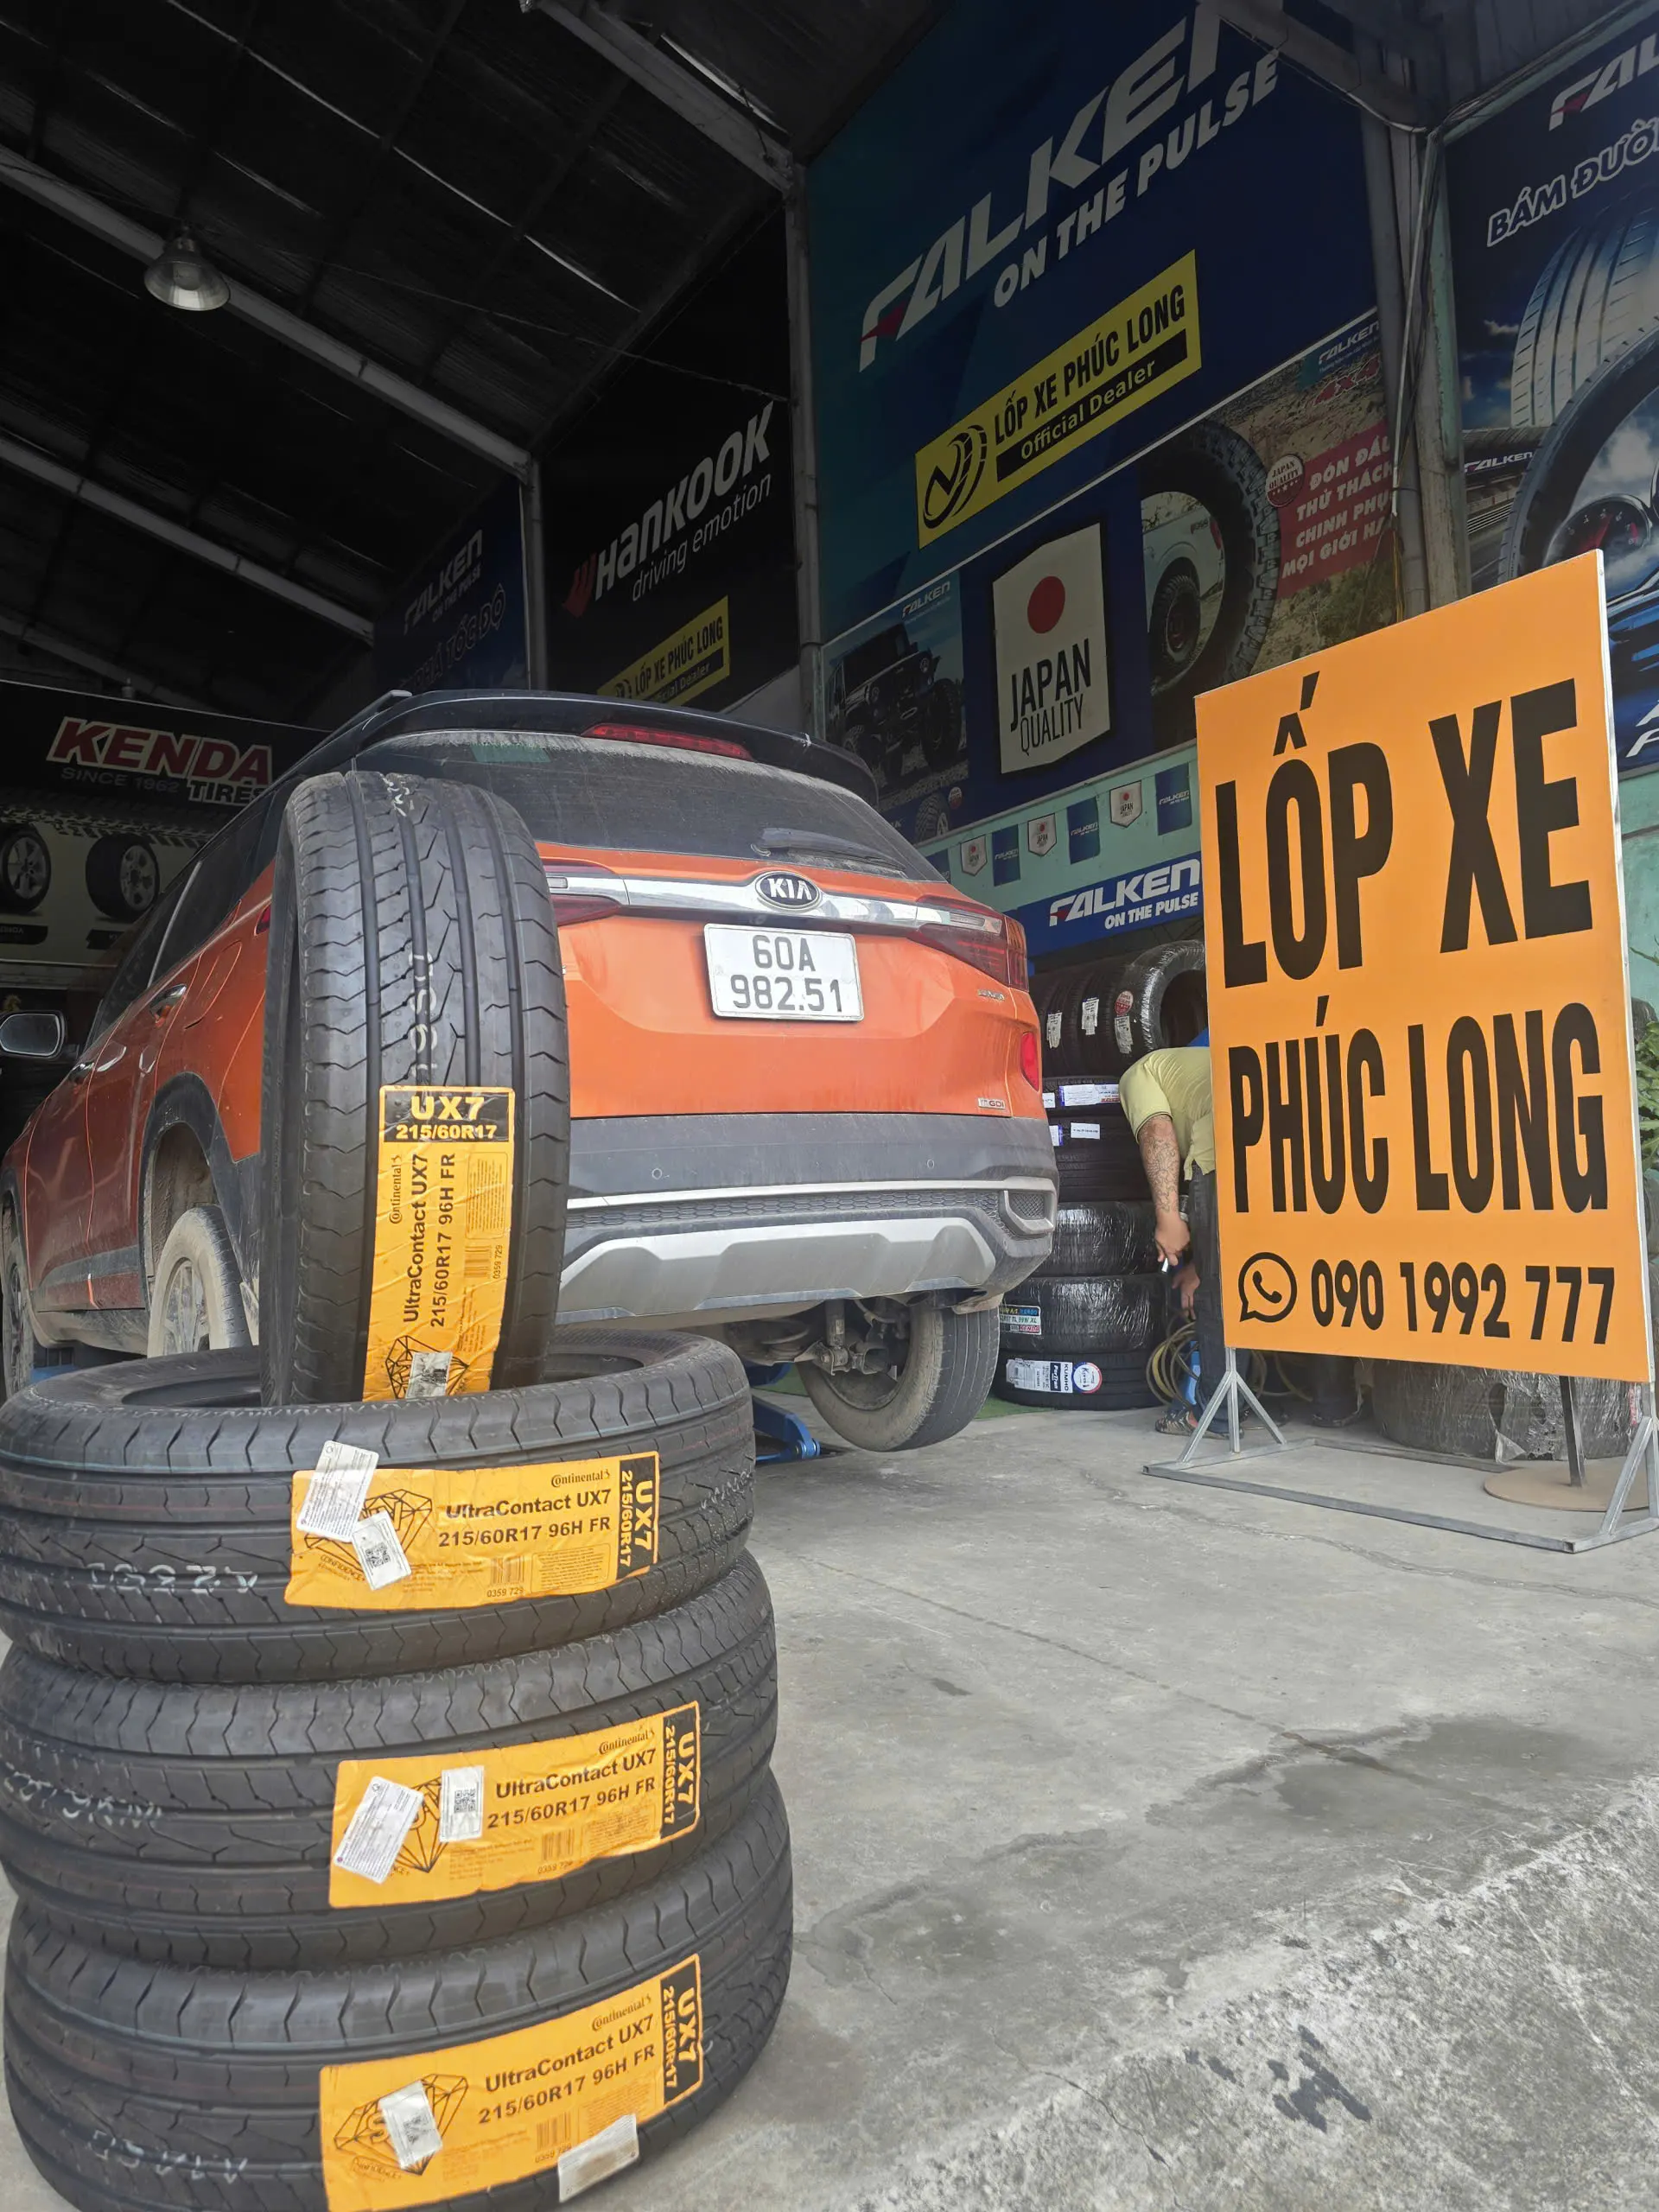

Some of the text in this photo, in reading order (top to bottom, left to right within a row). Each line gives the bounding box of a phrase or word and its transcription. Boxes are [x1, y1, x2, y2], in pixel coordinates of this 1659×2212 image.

[993, 48, 1280, 308] ON THE PULSE
[1487, 117, 1659, 247] BÁM ĐƯỜ
[993, 283, 1185, 446] LỐP XE PHÚC LONG
[1020, 358, 1156, 461] Official Dealer
[1269, 467, 1300, 489] QUALITY
[1272, 460, 1296, 478] JAPAN
[1310, 456, 1350, 491] ĐÓN
[1464, 451, 1533, 473] FALKEN
[632, 474, 771, 601] driving emotion
[1282, 550, 1314, 578] MỌI
[1320, 530, 1358, 560] GIỚI
[1296, 510, 1347, 548] CHINH
[404, 529, 483, 636] FALKEN
[634, 616, 723, 696] LỐP XE PHÚC LONG
[680, 662, 710, 690] Dealer
[1010, 639, 1092, 732] JAPAN
[46, 715, 273, 785] KENDA
[1020, 694, 1084, 755] QUALITY
[60, 767, 181, 792] SINCE 1962
[1216, 671, 1593, 988] LỐP XE
[769, 877, 811, 900] KIA
[1049, 859, 1200, 927] FALKEN
[1105, 892, 1198, 930] ON THE PULSE
[752, 935, 816, 971] 60A
[730, 974, 842, 1013] 982.51
[396, 1124, 498, 1141] 215/60R17
[410, 1096, 485, 1121] UX7
[1228, 995, 1608, 1214] PHÚC LONG
[389, 1163, 403, 1224] Continental
[404, 1154, 429, 1324] UltraContact UX7
[430, 1153, 455, 1328] 215/60R17 96H FR
[493, 1262, 501, 1279] 0359
[1311, 1259, 1615, 1344] 090 1992 777
[446, 1489, 612, 1519] UltraContact UX7
[551, 1473, 604, 1488] Continental
[439, 1517, 611, 1548] 215/60R17 96H FR
[620, 1470, 633, 1567] 215/60R17
[635, 1481, 654, 1551] UX7
[487, 1588, 506, 1598] 0359
[599, 1732, 650, 1755] Continental
[677, 1732, 696, 1805] UX7
[487, 1778, 656, 1829] 215/60R17 96H FR
[496, 1749, 657, 1800] UltraContact UX7
[663, 1725, 677, 1825] 215/60R17
[592, 1999, 645, 2032] Continental
[663, 1986, 677, 2088] 215/60R17
[677, 1987, 696, 2063] UX7
[486, 2013, 654, 2093] UltraContact UX7
[479, 2045, 656, 2125] 215/60R17 96H FR
